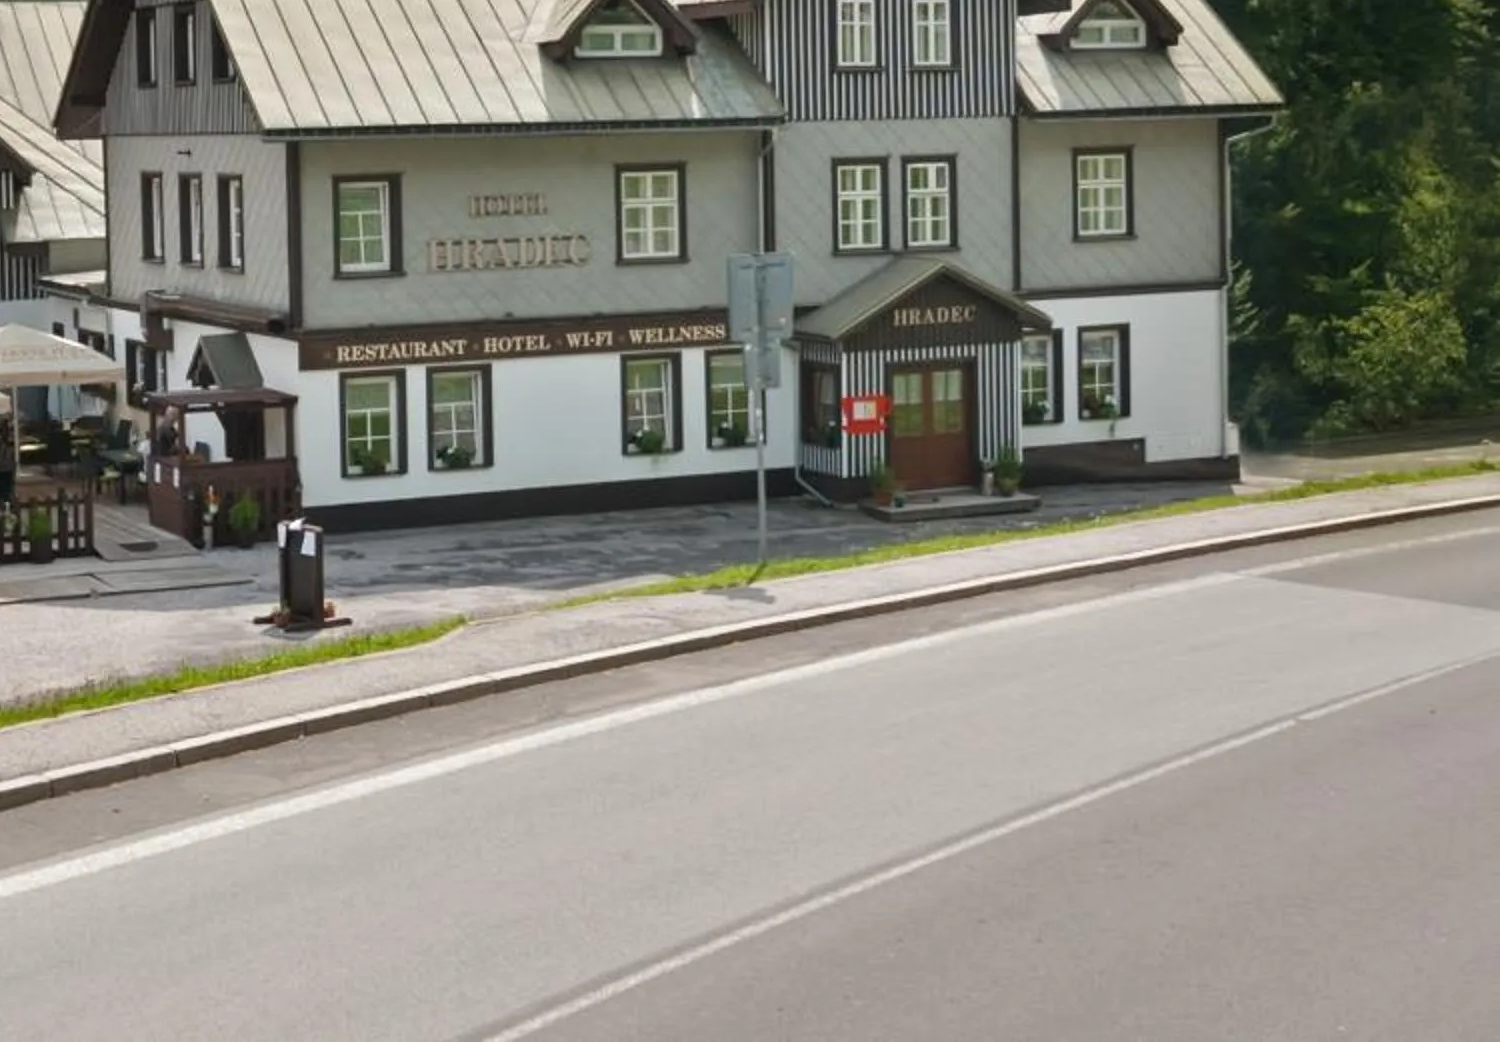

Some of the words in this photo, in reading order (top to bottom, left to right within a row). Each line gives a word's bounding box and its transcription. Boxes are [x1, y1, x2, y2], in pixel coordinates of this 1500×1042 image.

[427, 234, 591, 273] HRADEC
[893, 304, 977, 327] HRADEC
[336, 339, 468, 363] RESTAURANT
[483, 333, 551, 354] HOTEL
[628, 324, 725, 345] WELLNESS
